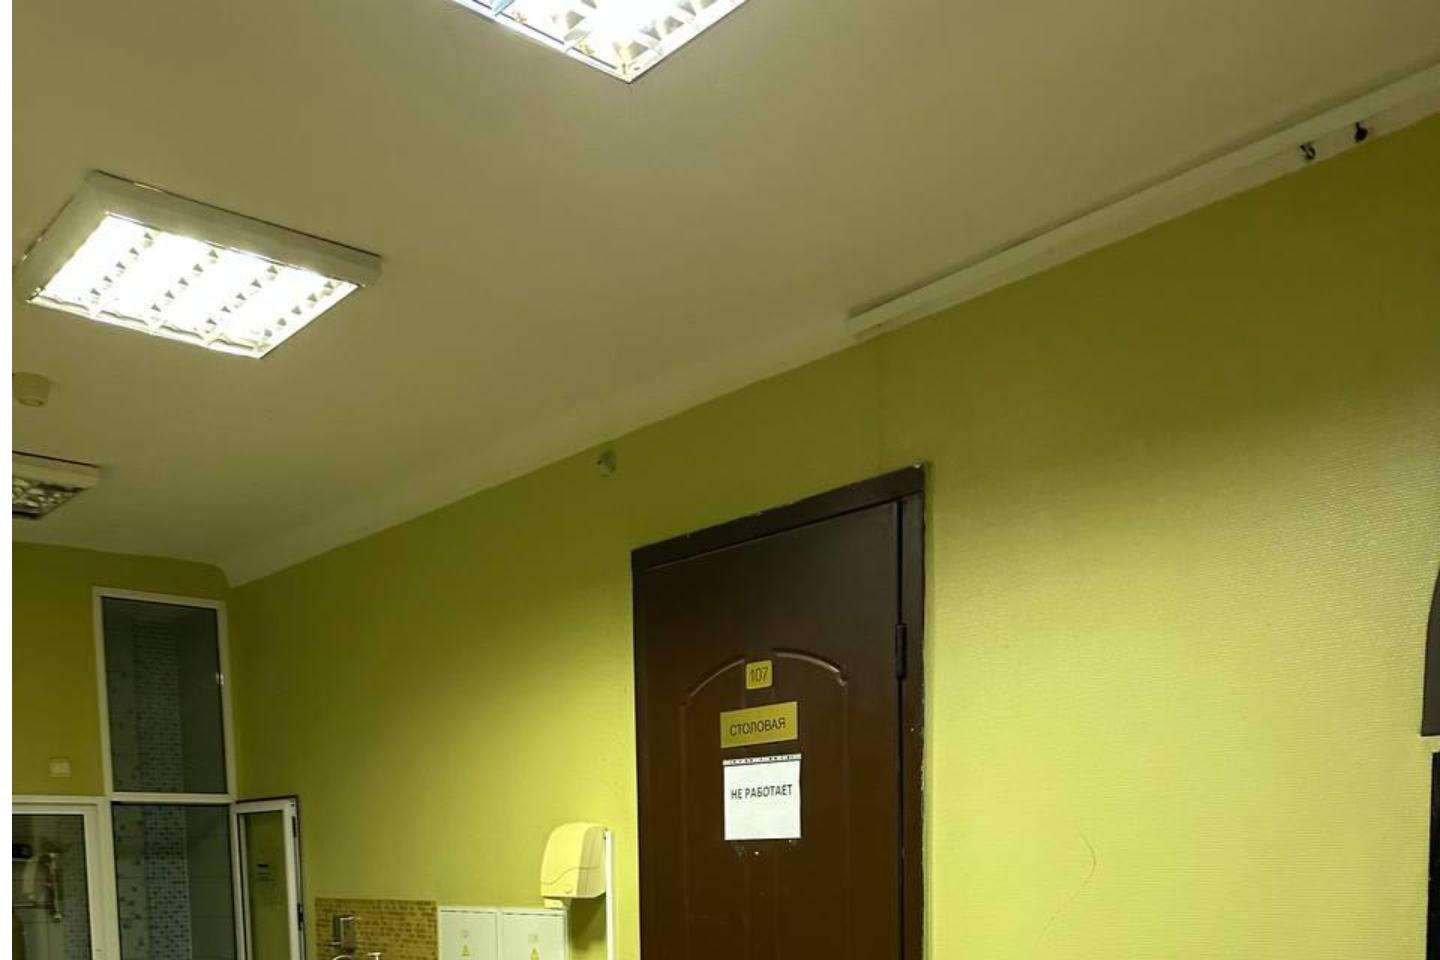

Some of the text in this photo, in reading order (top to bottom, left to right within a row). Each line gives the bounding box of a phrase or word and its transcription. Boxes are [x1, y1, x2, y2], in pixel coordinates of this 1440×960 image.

[750, 666, 769, 683] 107
[730, 717, 786, 736] СТОЛОВАЯ
[731, 784, 792, 799] НЕ РАБОТАЕТ
